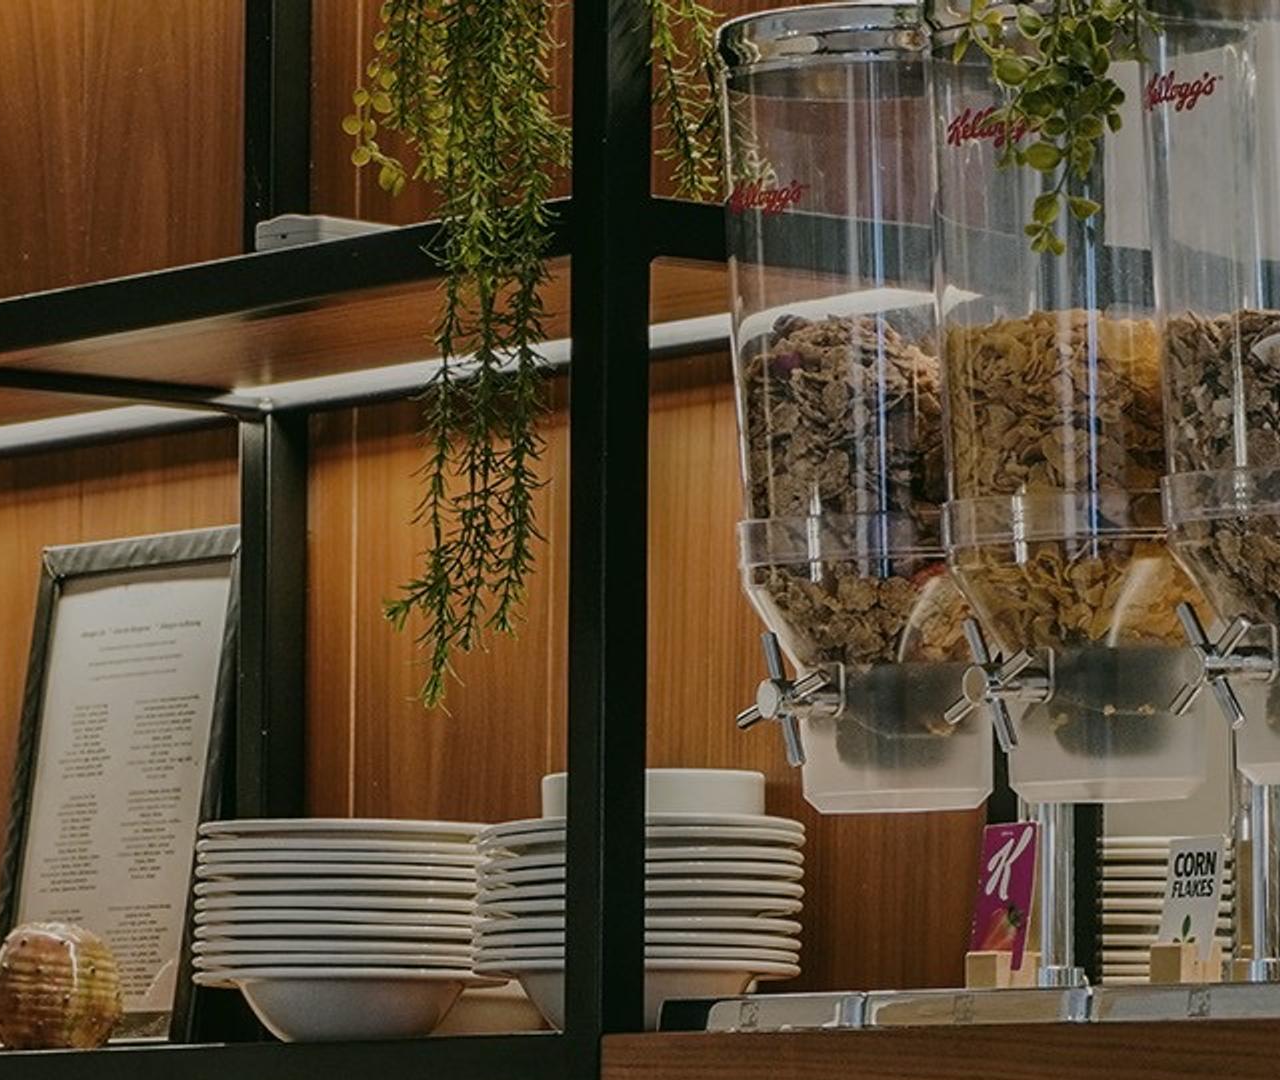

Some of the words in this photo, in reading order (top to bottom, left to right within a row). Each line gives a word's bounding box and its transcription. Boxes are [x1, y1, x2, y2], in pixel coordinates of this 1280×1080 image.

[1144, 70, 1217, 112] Kellogg's
[985, 825, 1033, 901] K
[1174, 851, 1217, 878] CORN
[1171, 878, 1214, 898] FLAKES
